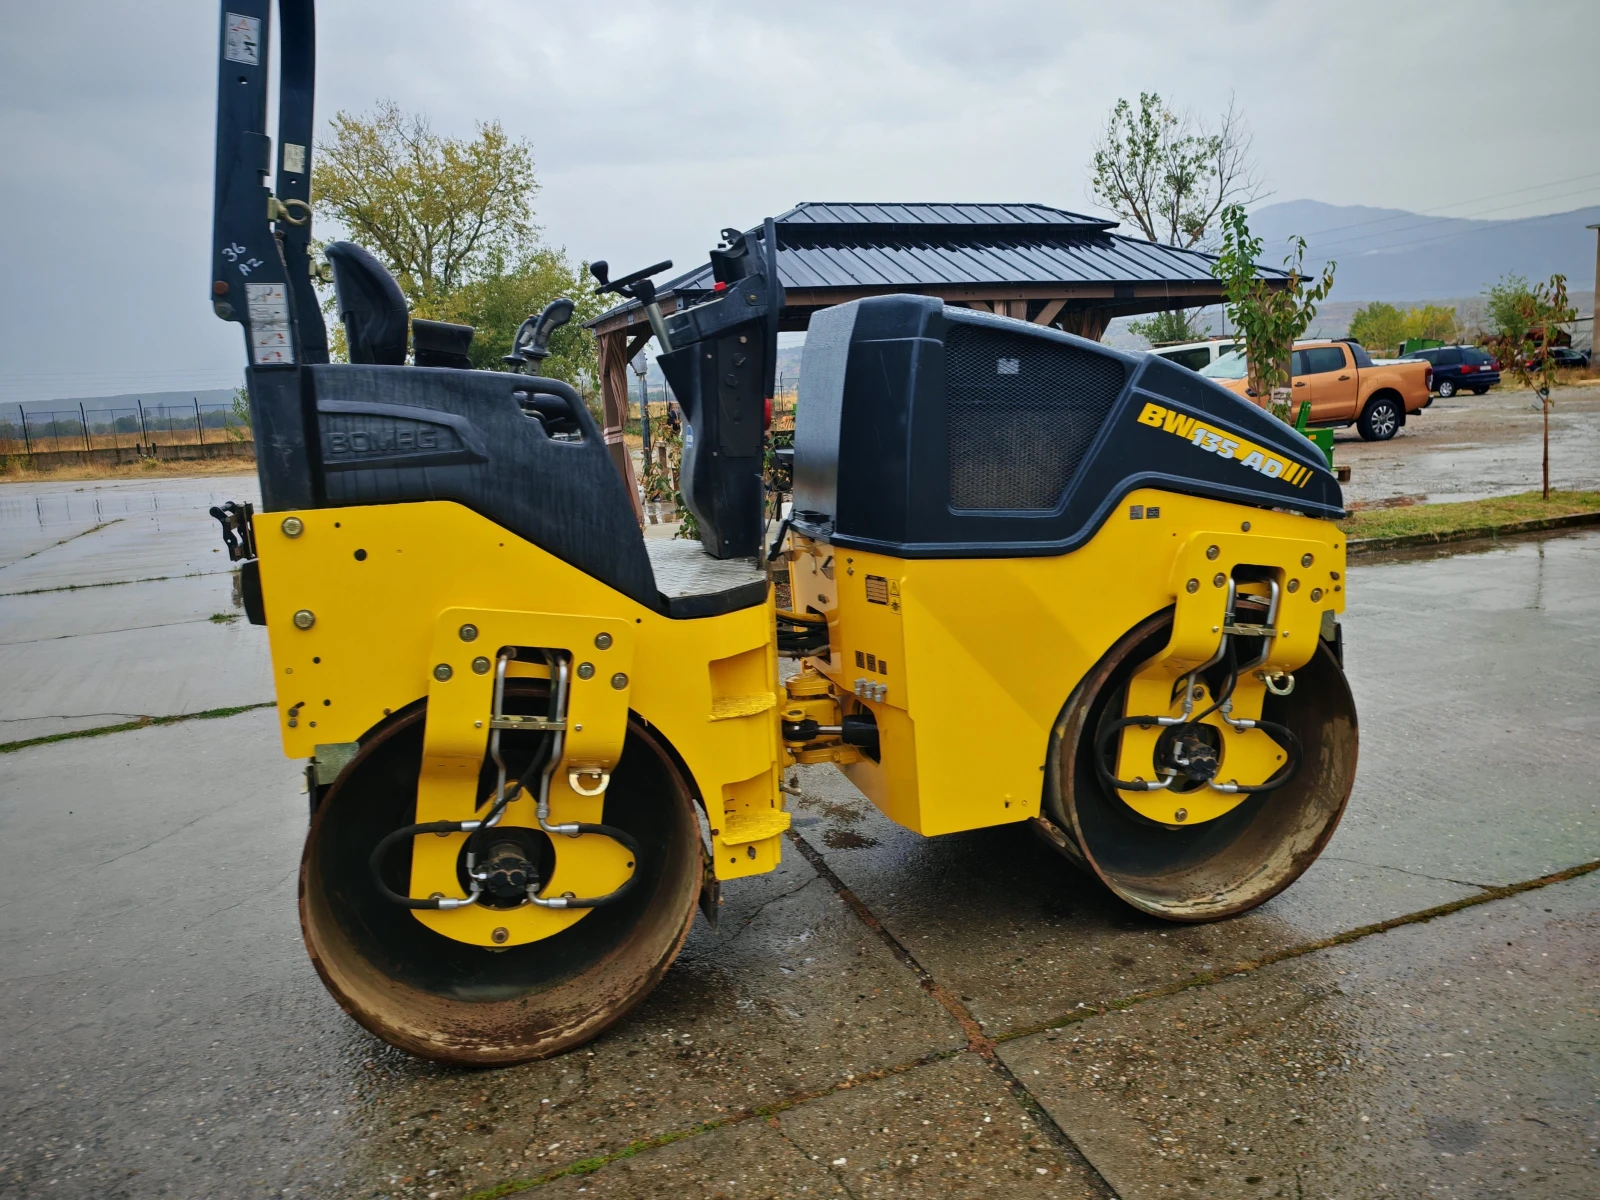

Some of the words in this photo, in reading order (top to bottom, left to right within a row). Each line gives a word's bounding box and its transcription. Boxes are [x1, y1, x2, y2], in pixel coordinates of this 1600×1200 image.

[222, 242, 246, 262] 36
[328, 430, 437, 453] BOMAG
[1240, 450, 1283, 479] AD
